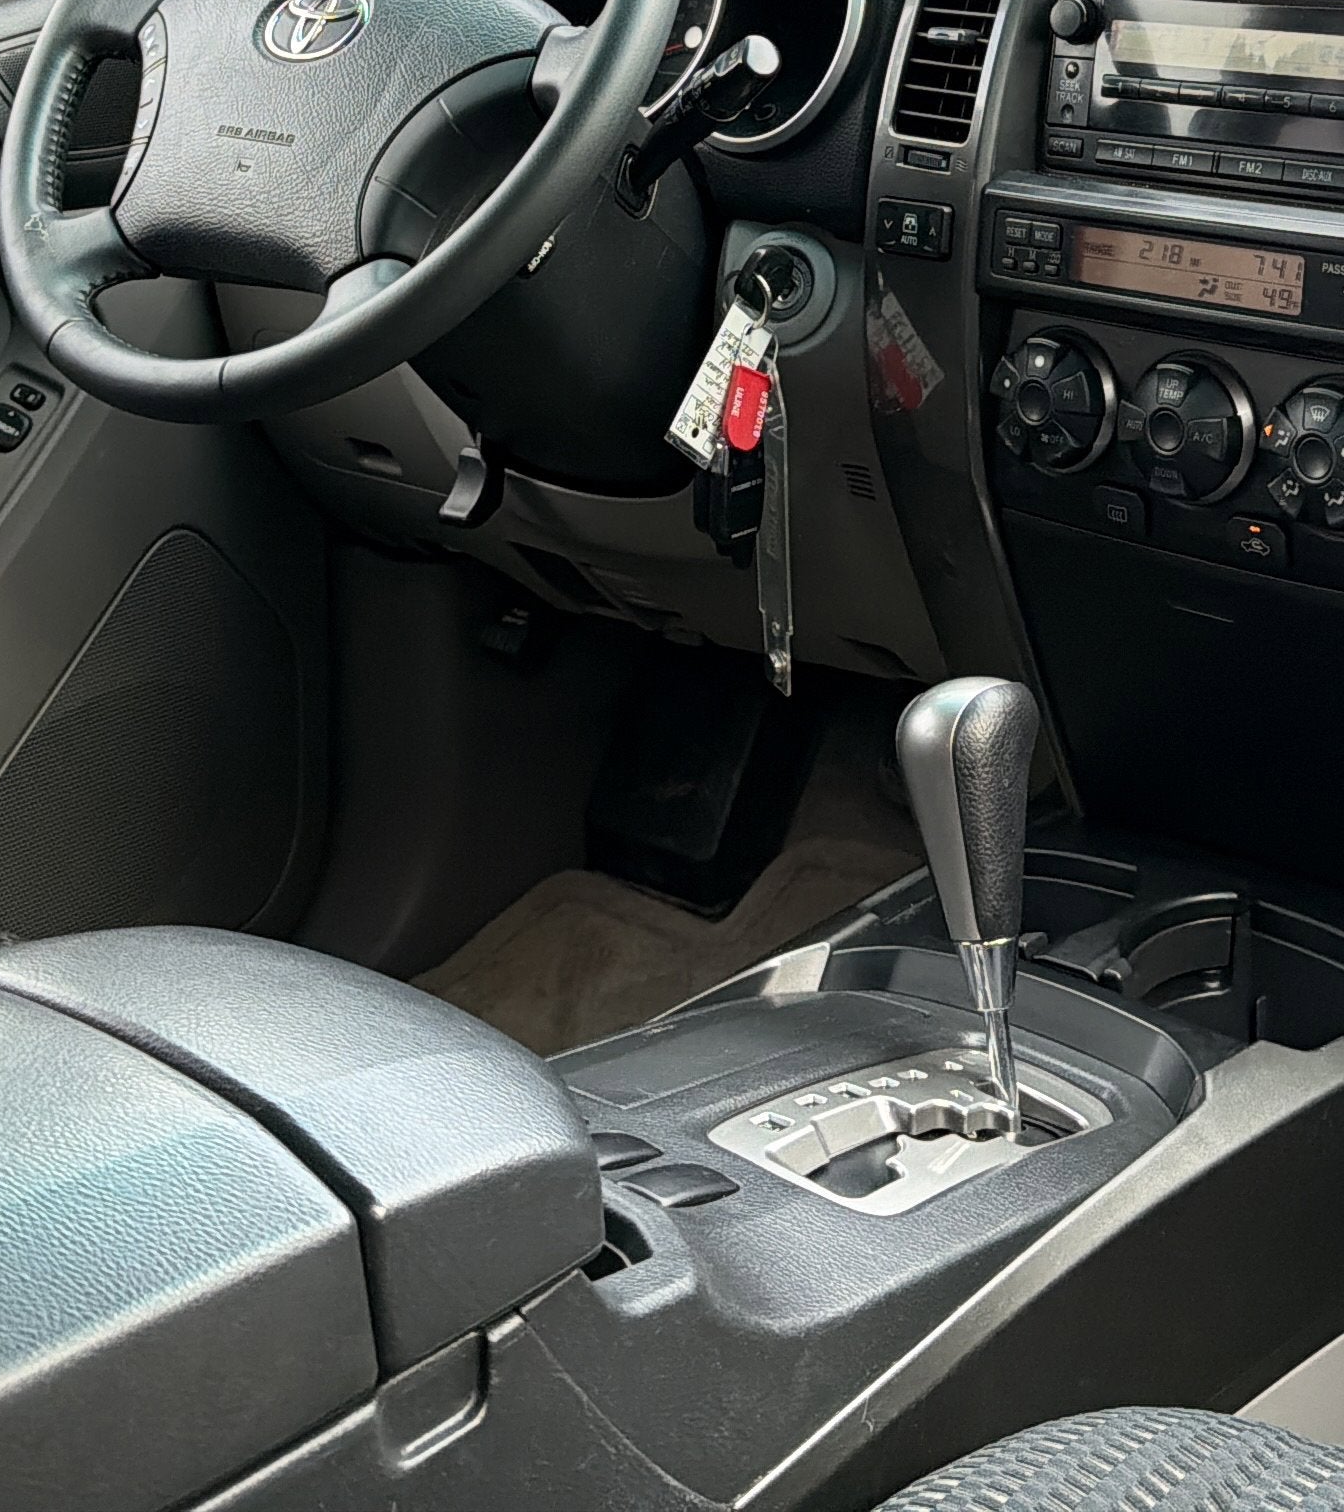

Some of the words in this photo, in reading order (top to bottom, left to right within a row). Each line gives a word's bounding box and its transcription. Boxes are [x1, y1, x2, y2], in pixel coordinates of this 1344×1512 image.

[1059, 79, 1081, 92] SEEK
[1056, 91, 1084, 103] TRACK
[1283, 97, 1291, 109] 5
[1328, 101, 1337, 113] 6
[244, 128, 295, 144] AIRBAG
[1052, 141, 1077, 153] SCAN
[1172, 154, 1193, 167] FM1
[1239, 161, 1263, 175] FM2
[1006, 227, 1027, 239] RESET
[1034, 230, 1055, 242] MODE
[900, 235, 918, 246] AUTO
[1166, 378, 1179, 389] UP
[1063, 389, 1073, 400] HI
[1159, 389, 1184, 400] TEMP
[731, 386, 745, 418] ULINE
[1193, 432, 1214, 444] A/C
